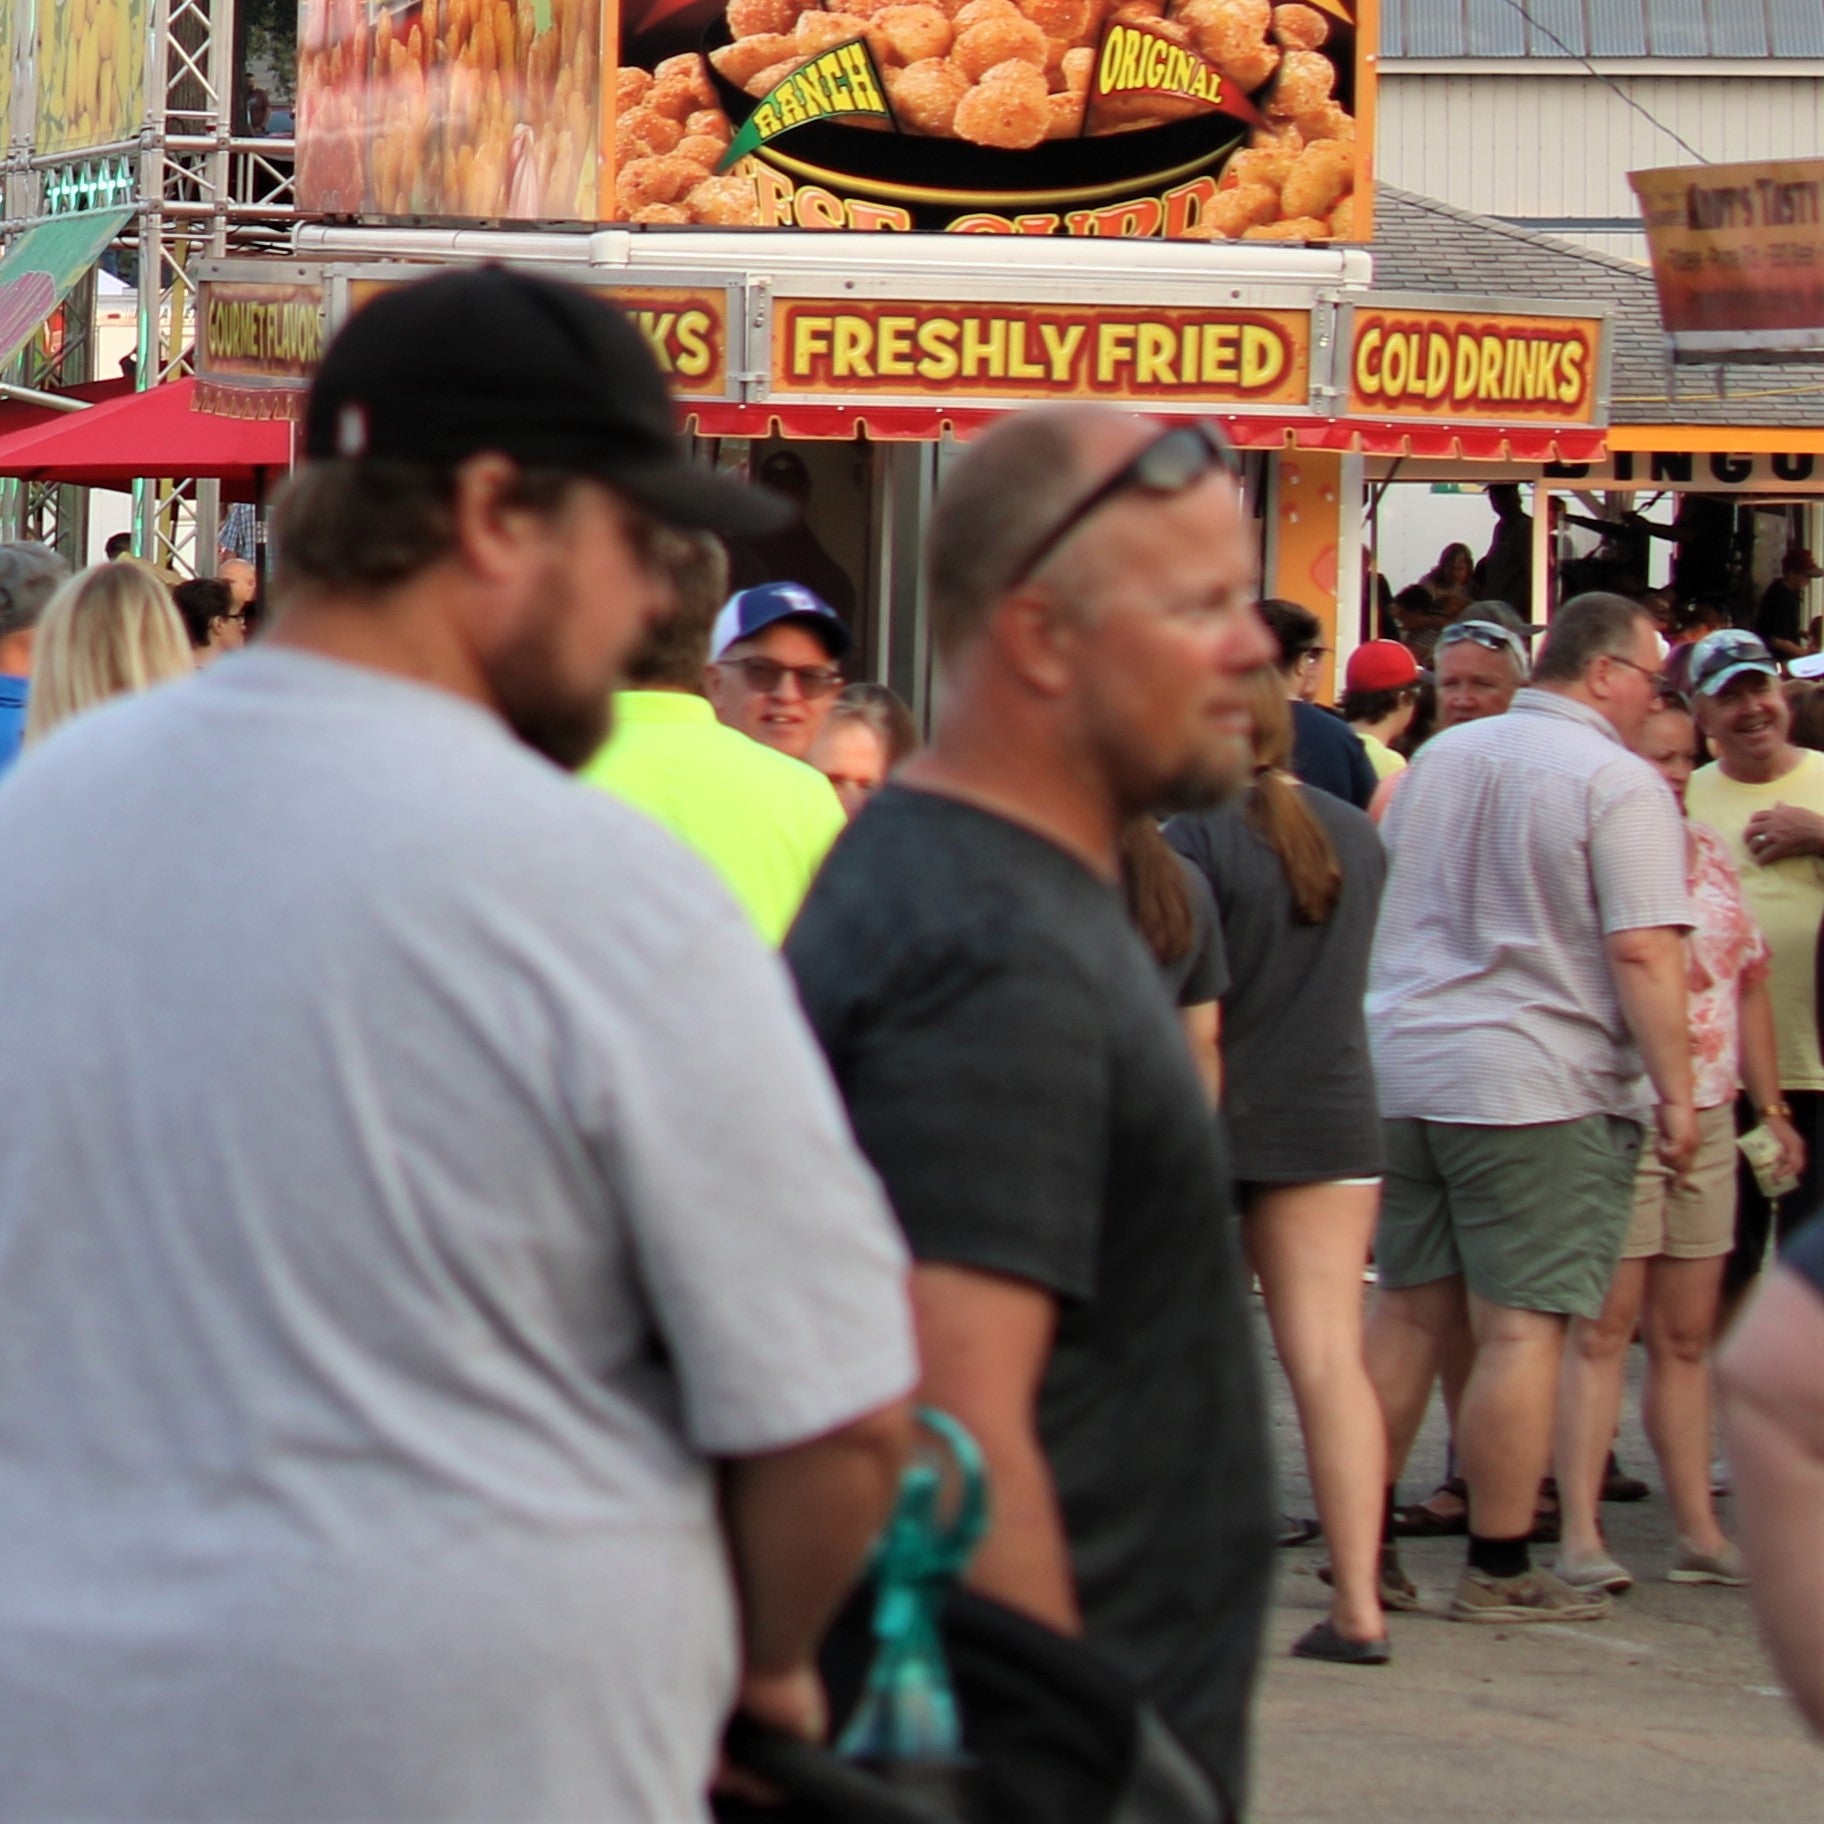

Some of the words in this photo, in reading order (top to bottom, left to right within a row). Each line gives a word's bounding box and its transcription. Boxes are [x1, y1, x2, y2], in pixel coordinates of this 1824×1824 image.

[753, 39, 891, 142] RANCH
[1098, 24, 1226, 105] ORIGINAL
[209, 297, 265, 359] GOURMET
[267, 301, 323, 363] FLAVORS
[793, 314, 1086, 386] FRESHLY
[1097, 318, 1286, 390] FRIED
[1357, 327, 1452, 400] COLD
[1454, 333, 1585, 405] DRINKS
